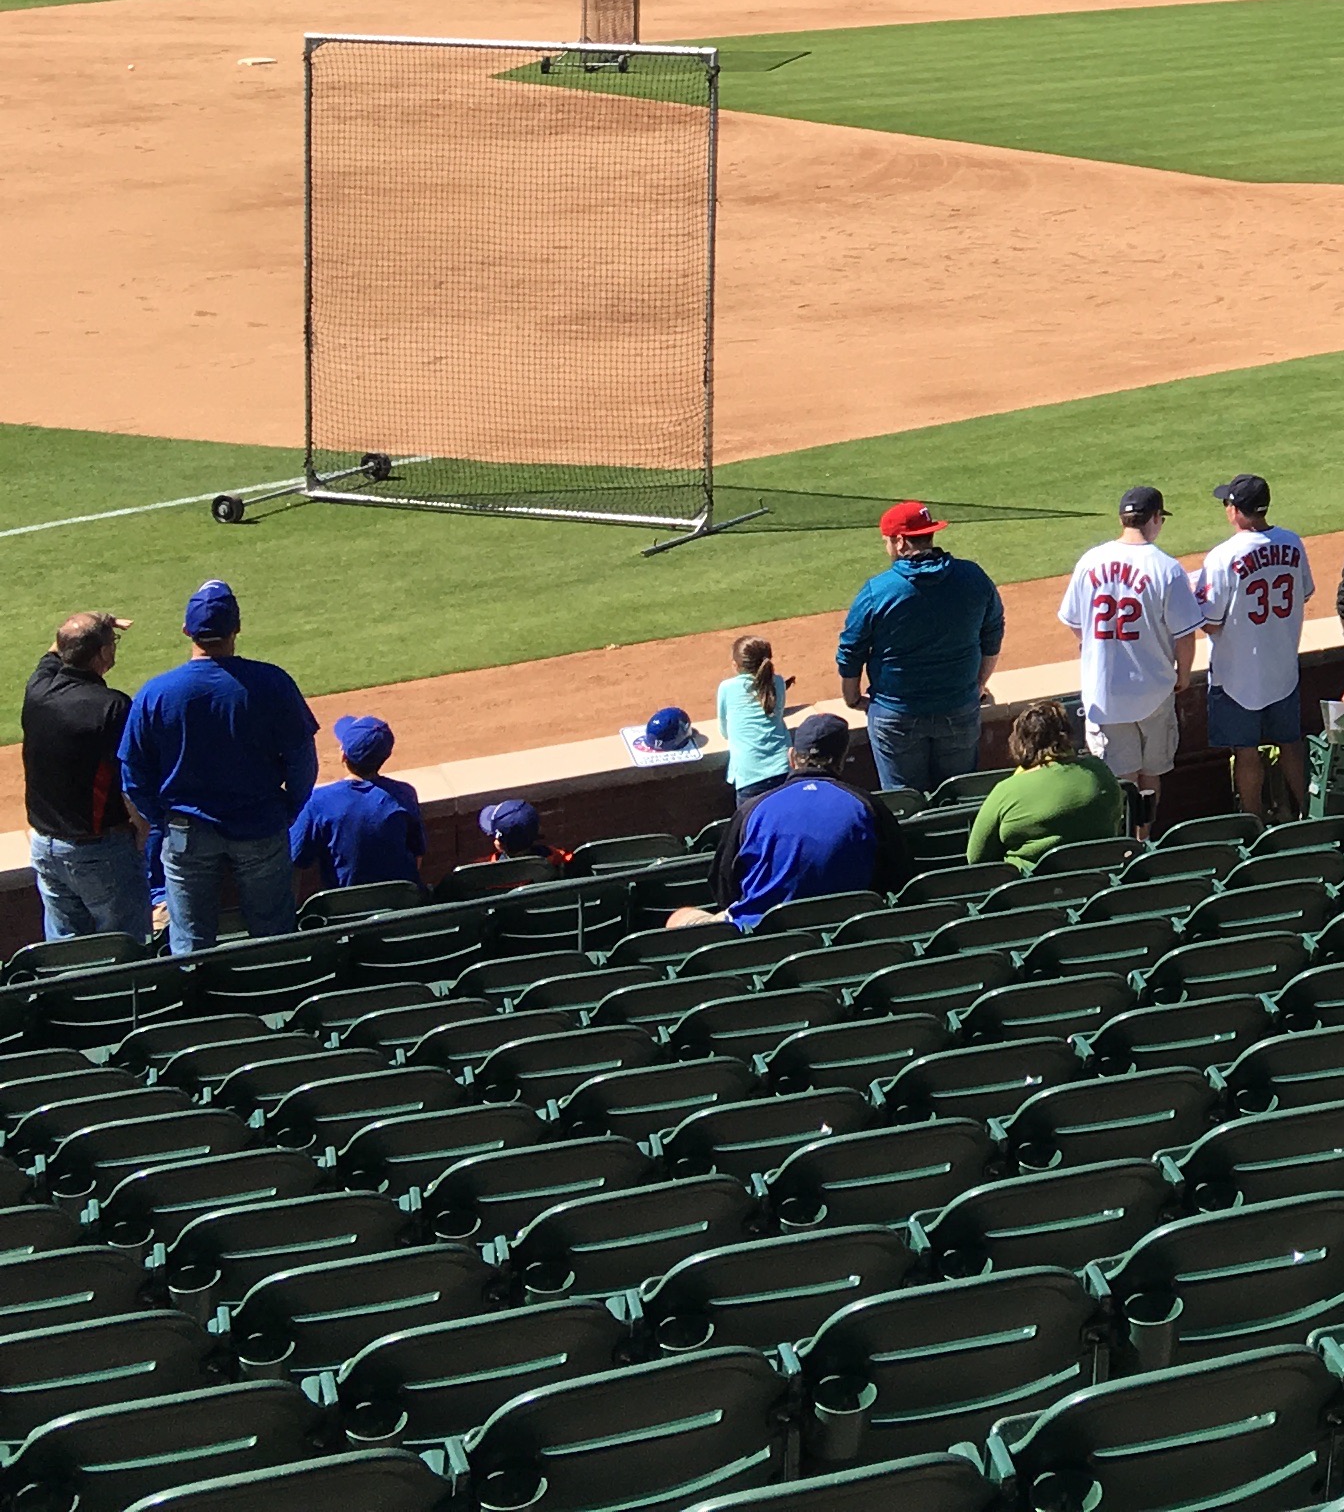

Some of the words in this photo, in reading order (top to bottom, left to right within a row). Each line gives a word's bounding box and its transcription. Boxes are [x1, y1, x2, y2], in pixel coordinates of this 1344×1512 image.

[1231, 544, 1301, 581] SWISHER
[1092, 594, 1143, 641] 22
[1245, 572, 1295, 626] 33
